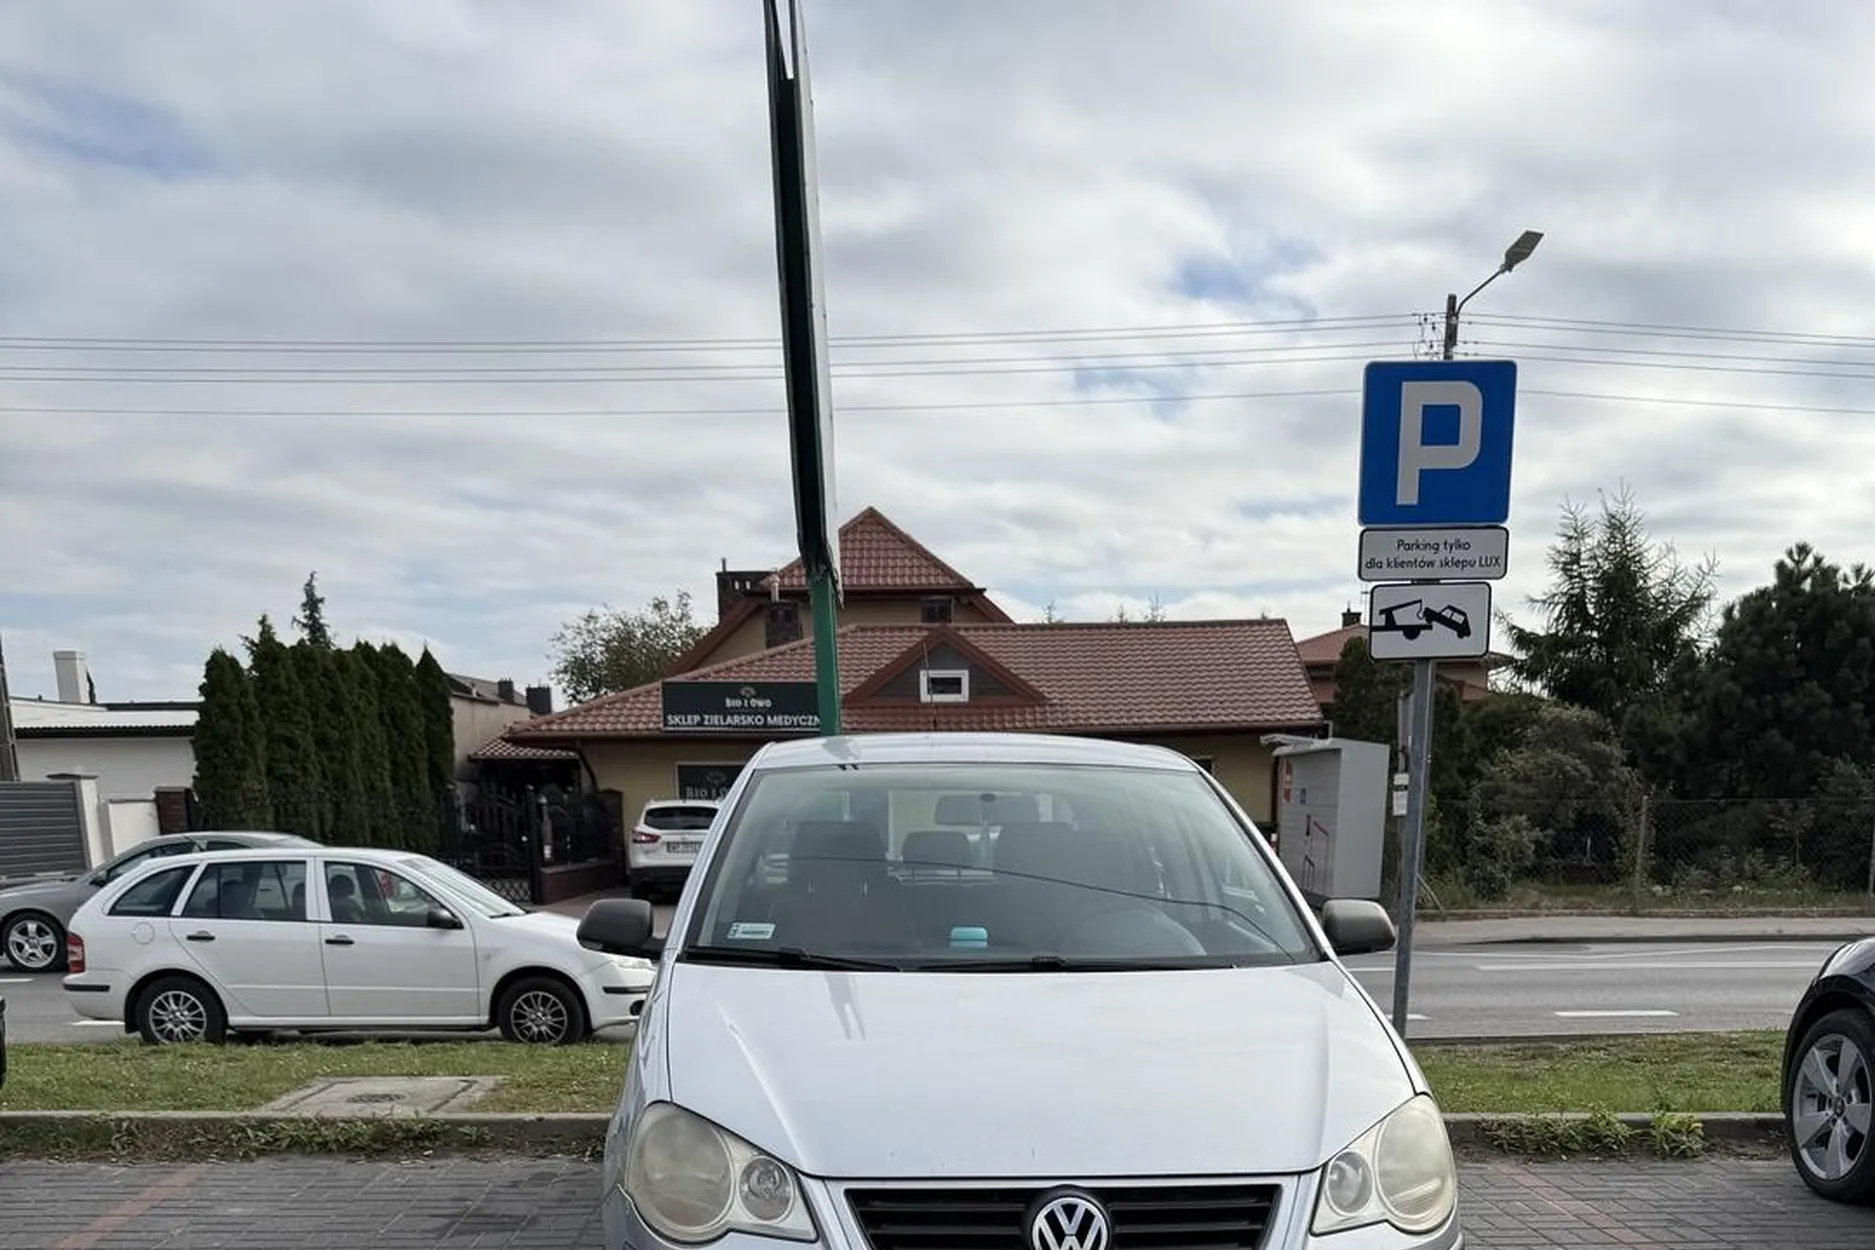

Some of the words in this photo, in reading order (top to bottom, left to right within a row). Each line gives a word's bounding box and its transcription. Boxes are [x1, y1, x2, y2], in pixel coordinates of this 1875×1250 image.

[1396, 380, 1483, 506] P
[1396, 539, 1440, 554] Parking
[1443, 540, 1471, 554] tylko
[1365, 557, 1383, 569] dla
[1386, 557, 1435, 569] klientów
[1439, 556, 1476, 571] sklepu
[1478, 555, 1501, 568] LUX
[667, 714, 700, 726] SKLEP
[703, 714, 764, 726] ZIELARSKO
[767, 714, 821, 726] MEDYCZN
